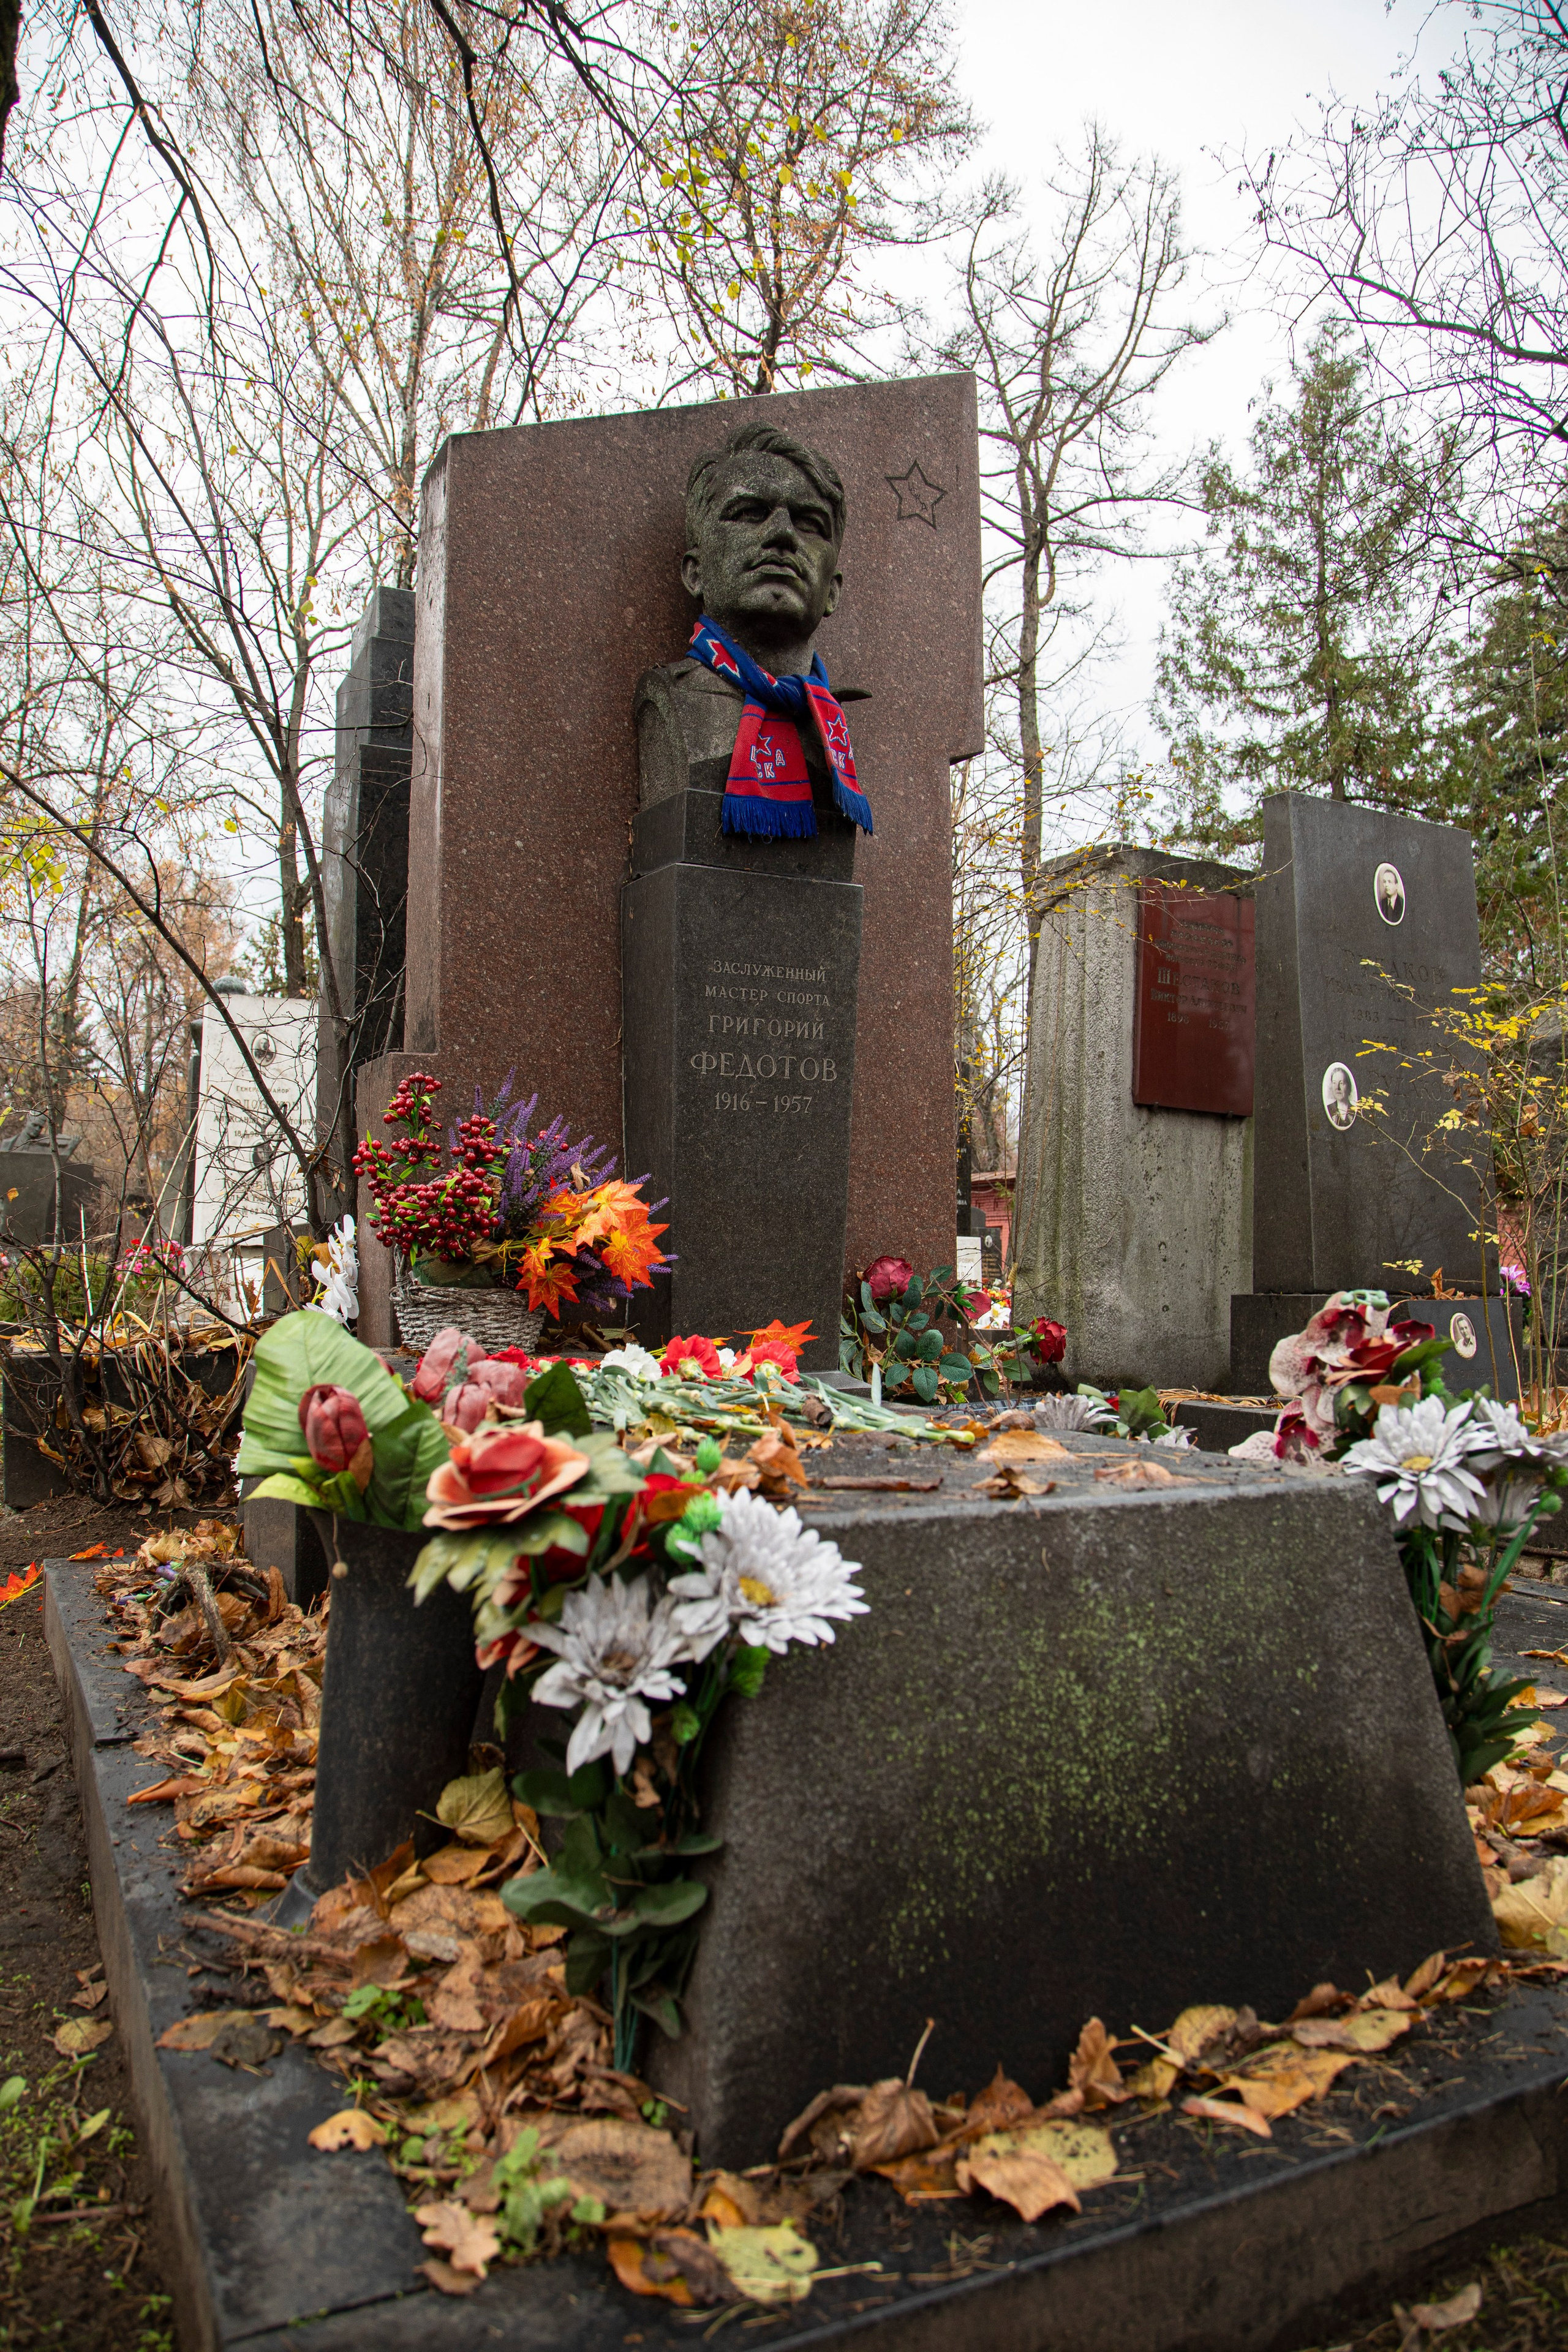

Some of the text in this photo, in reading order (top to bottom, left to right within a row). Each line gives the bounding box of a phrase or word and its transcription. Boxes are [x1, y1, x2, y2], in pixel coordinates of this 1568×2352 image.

[713, 960, 826, 981] ЗАСЛУЖЕННЫЙ
[1158, 967, 1240, 995] ШЕСТАКОВ
[704, 984, 830, 1006] МАСТЕР СПОРТА
[708, 1014, 824, 1039] ГРИГОРИЙ
[690, 1051, 838, 1082] ФЕДОТОВ
[714, 1092, 751, 1111] 1916
[774, 1095, 813, 1114] 1957
